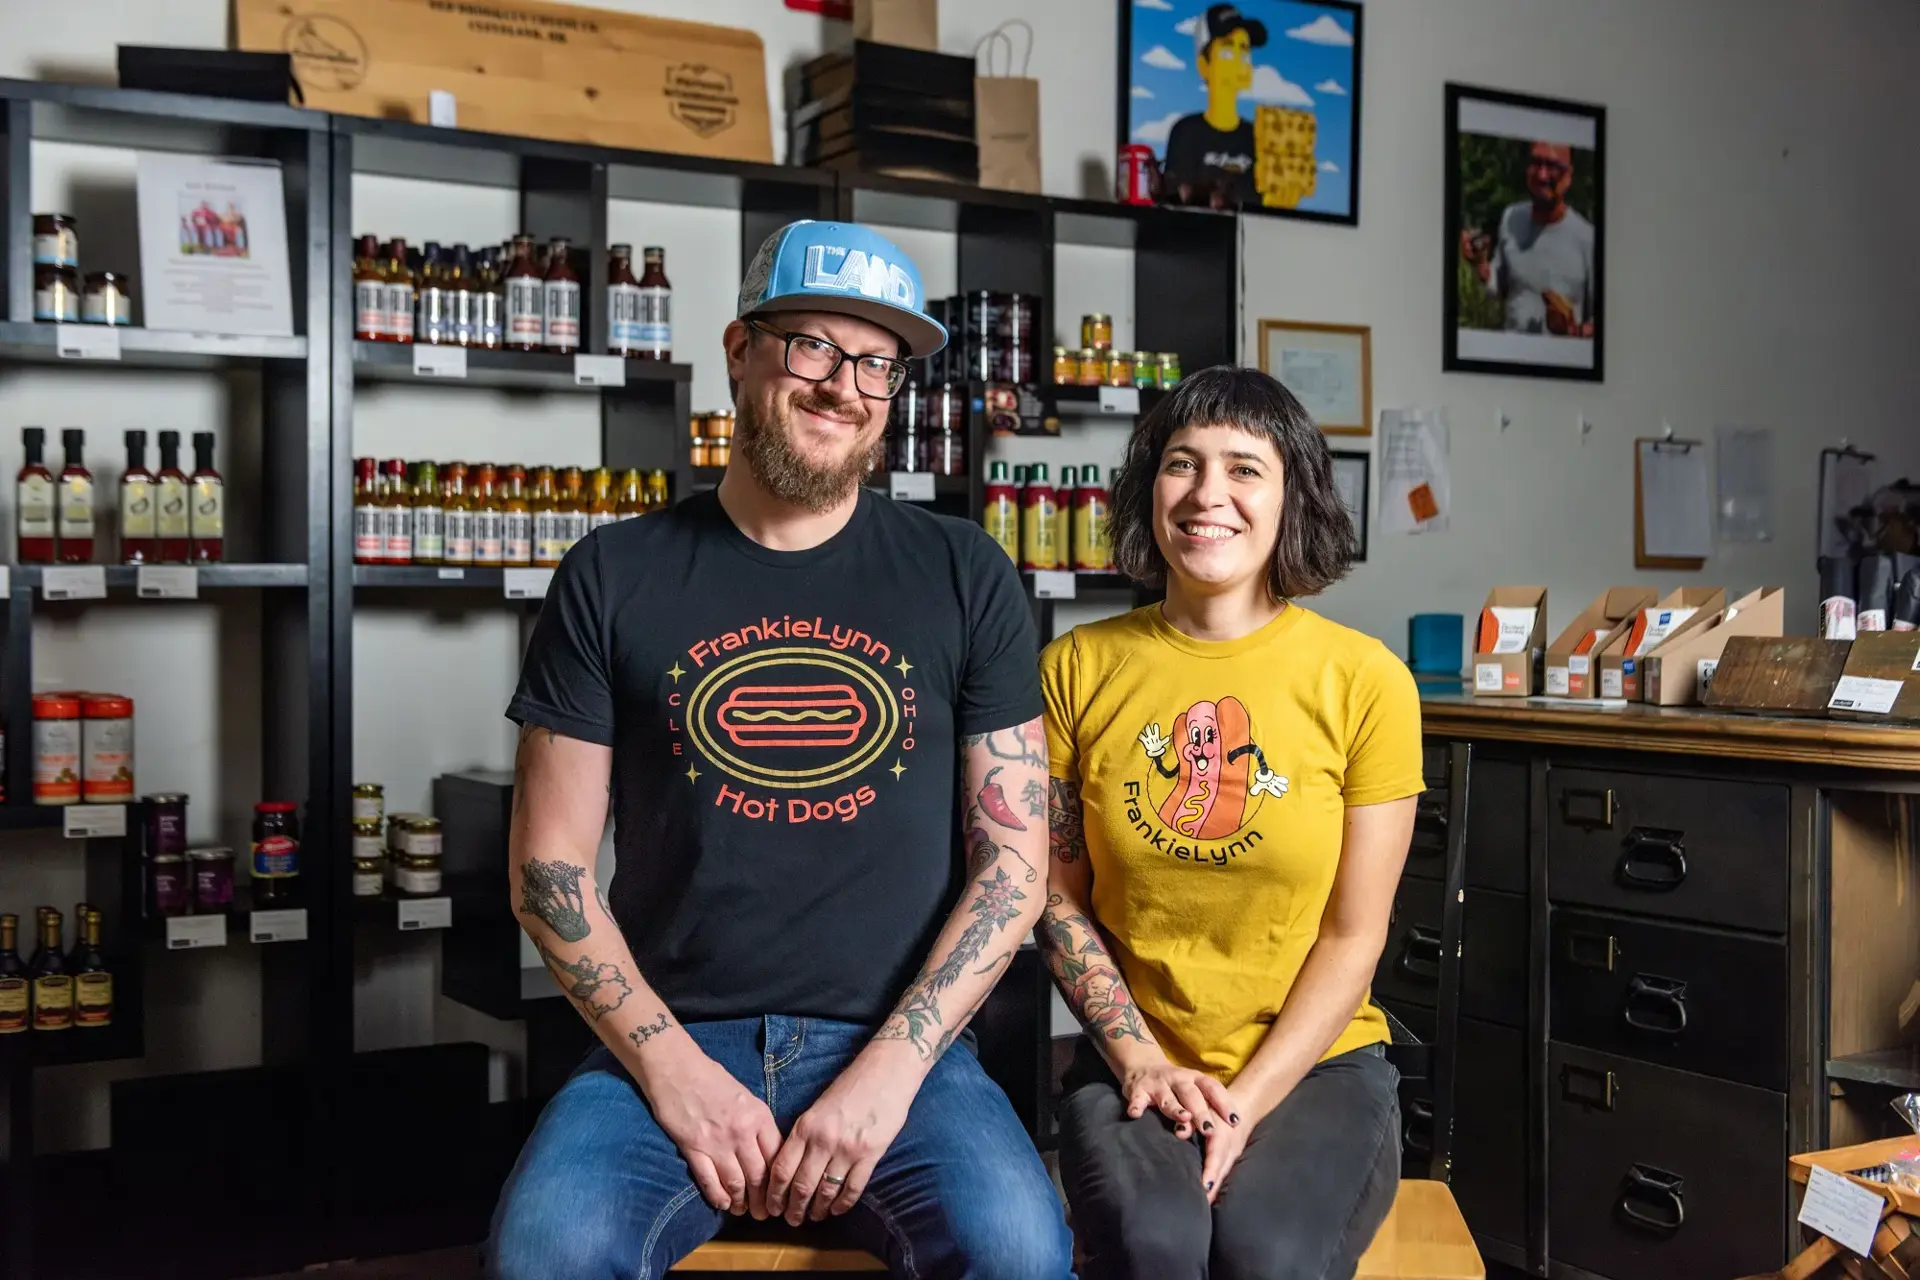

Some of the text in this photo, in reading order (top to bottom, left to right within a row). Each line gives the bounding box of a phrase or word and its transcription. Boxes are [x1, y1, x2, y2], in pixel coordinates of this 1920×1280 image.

[803, 245, 915, 308] LAND
[825, 245, 846, 257] THE
[688, 615, 891, 668] FrankieLynn
[901, 687, 916, 750] OHIO
[715, 784, 876, 824] Hot Dogs
[1124, 781, 1263, 866] FrankieLynn
